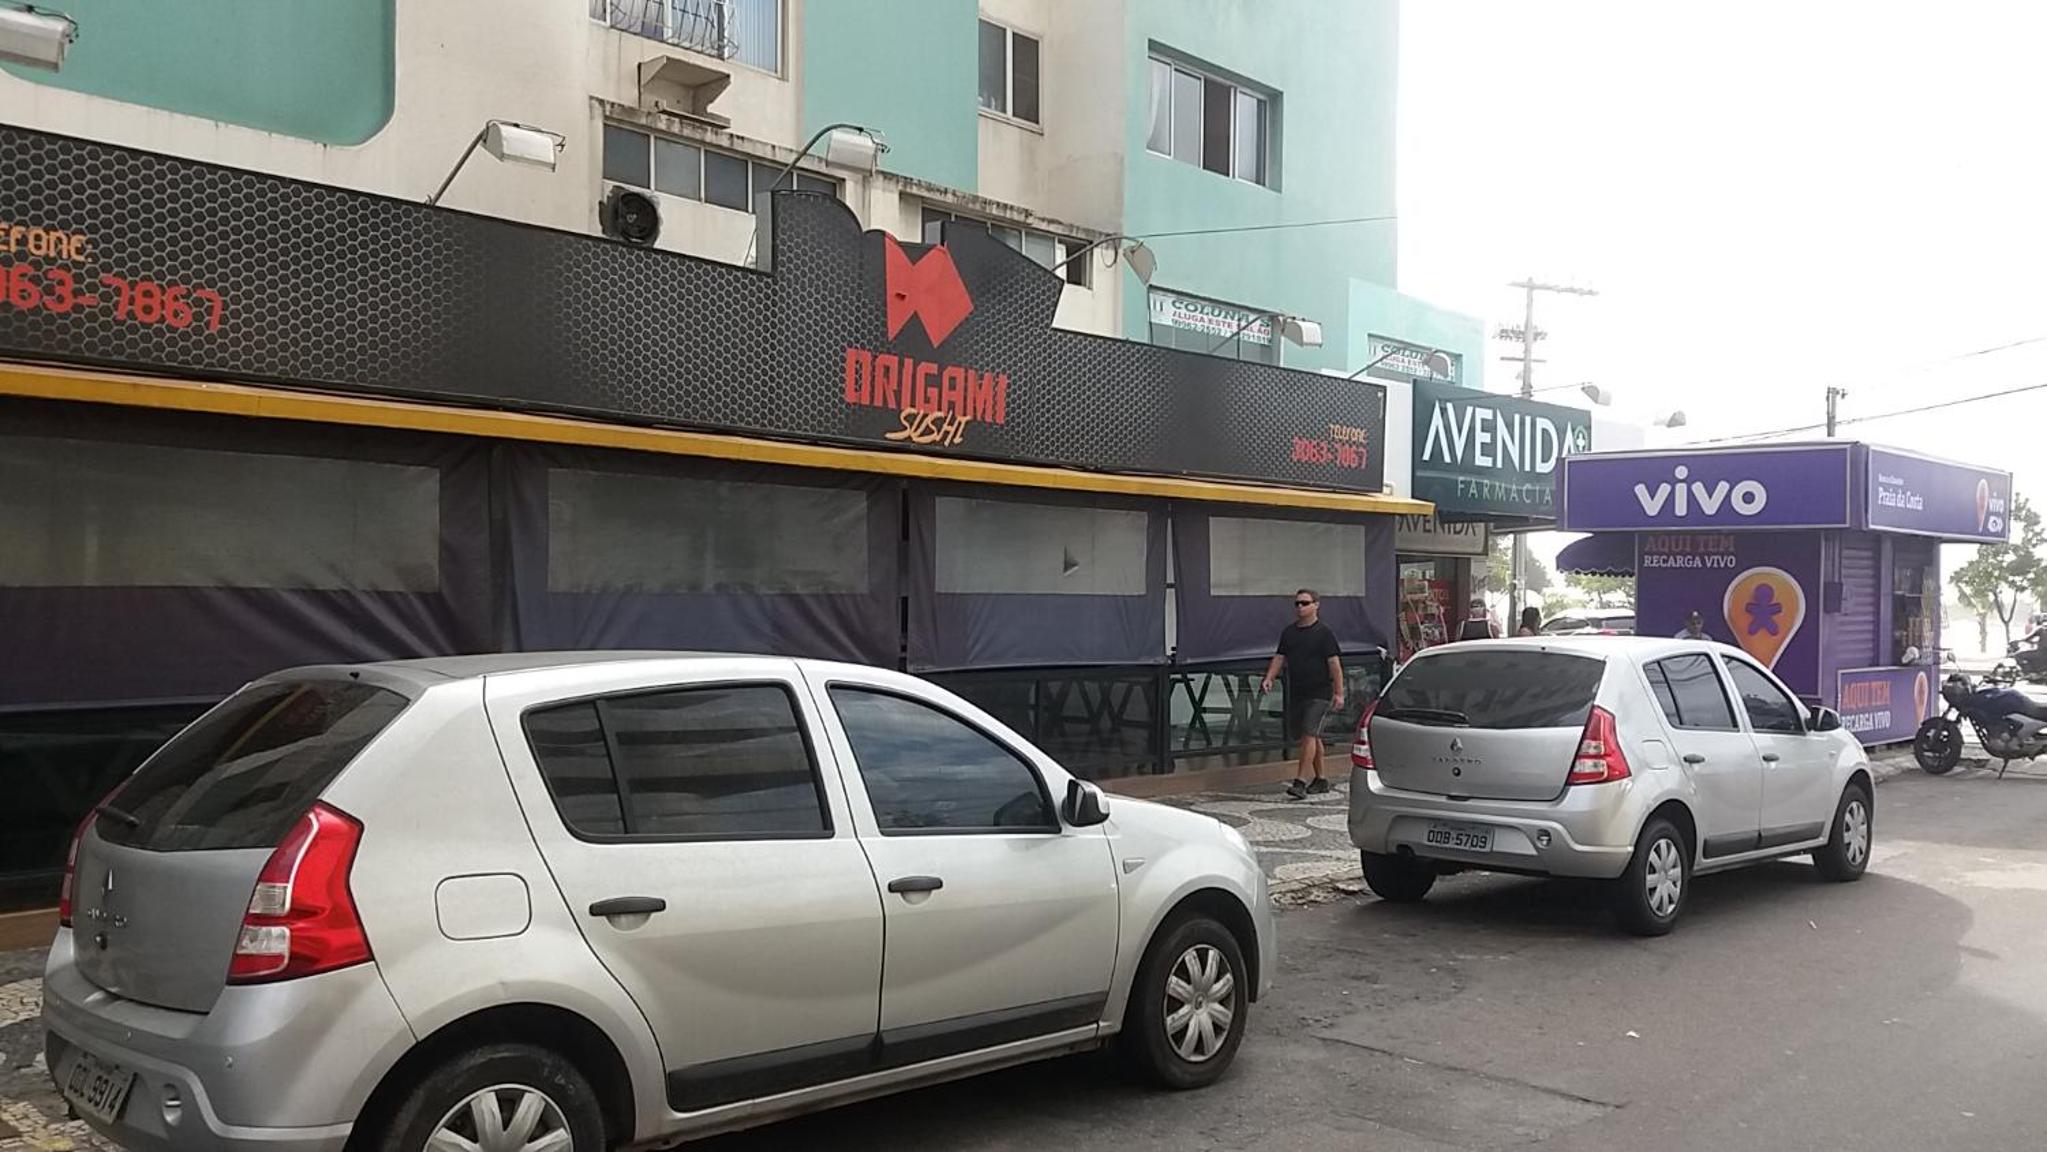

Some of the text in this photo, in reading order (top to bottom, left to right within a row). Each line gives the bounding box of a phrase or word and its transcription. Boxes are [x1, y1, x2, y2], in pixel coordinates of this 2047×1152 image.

[0, 263, 223, 333] 63-7867
[845, 347, 1007, 426] ORIGAMI
[885, 407, 972, 447] SUSHI
[1421, 399, 1576, 475] AVENIDA
[1633, 465, 1767, 517] vivo
[1878, 487, 1896, 507] Praia
[1906, 491, 1923, 511] Costa
[1643, 554, 1737, 568] RECARGA VIVO
[1644, 534, 1736, 553] AQUI TEM
